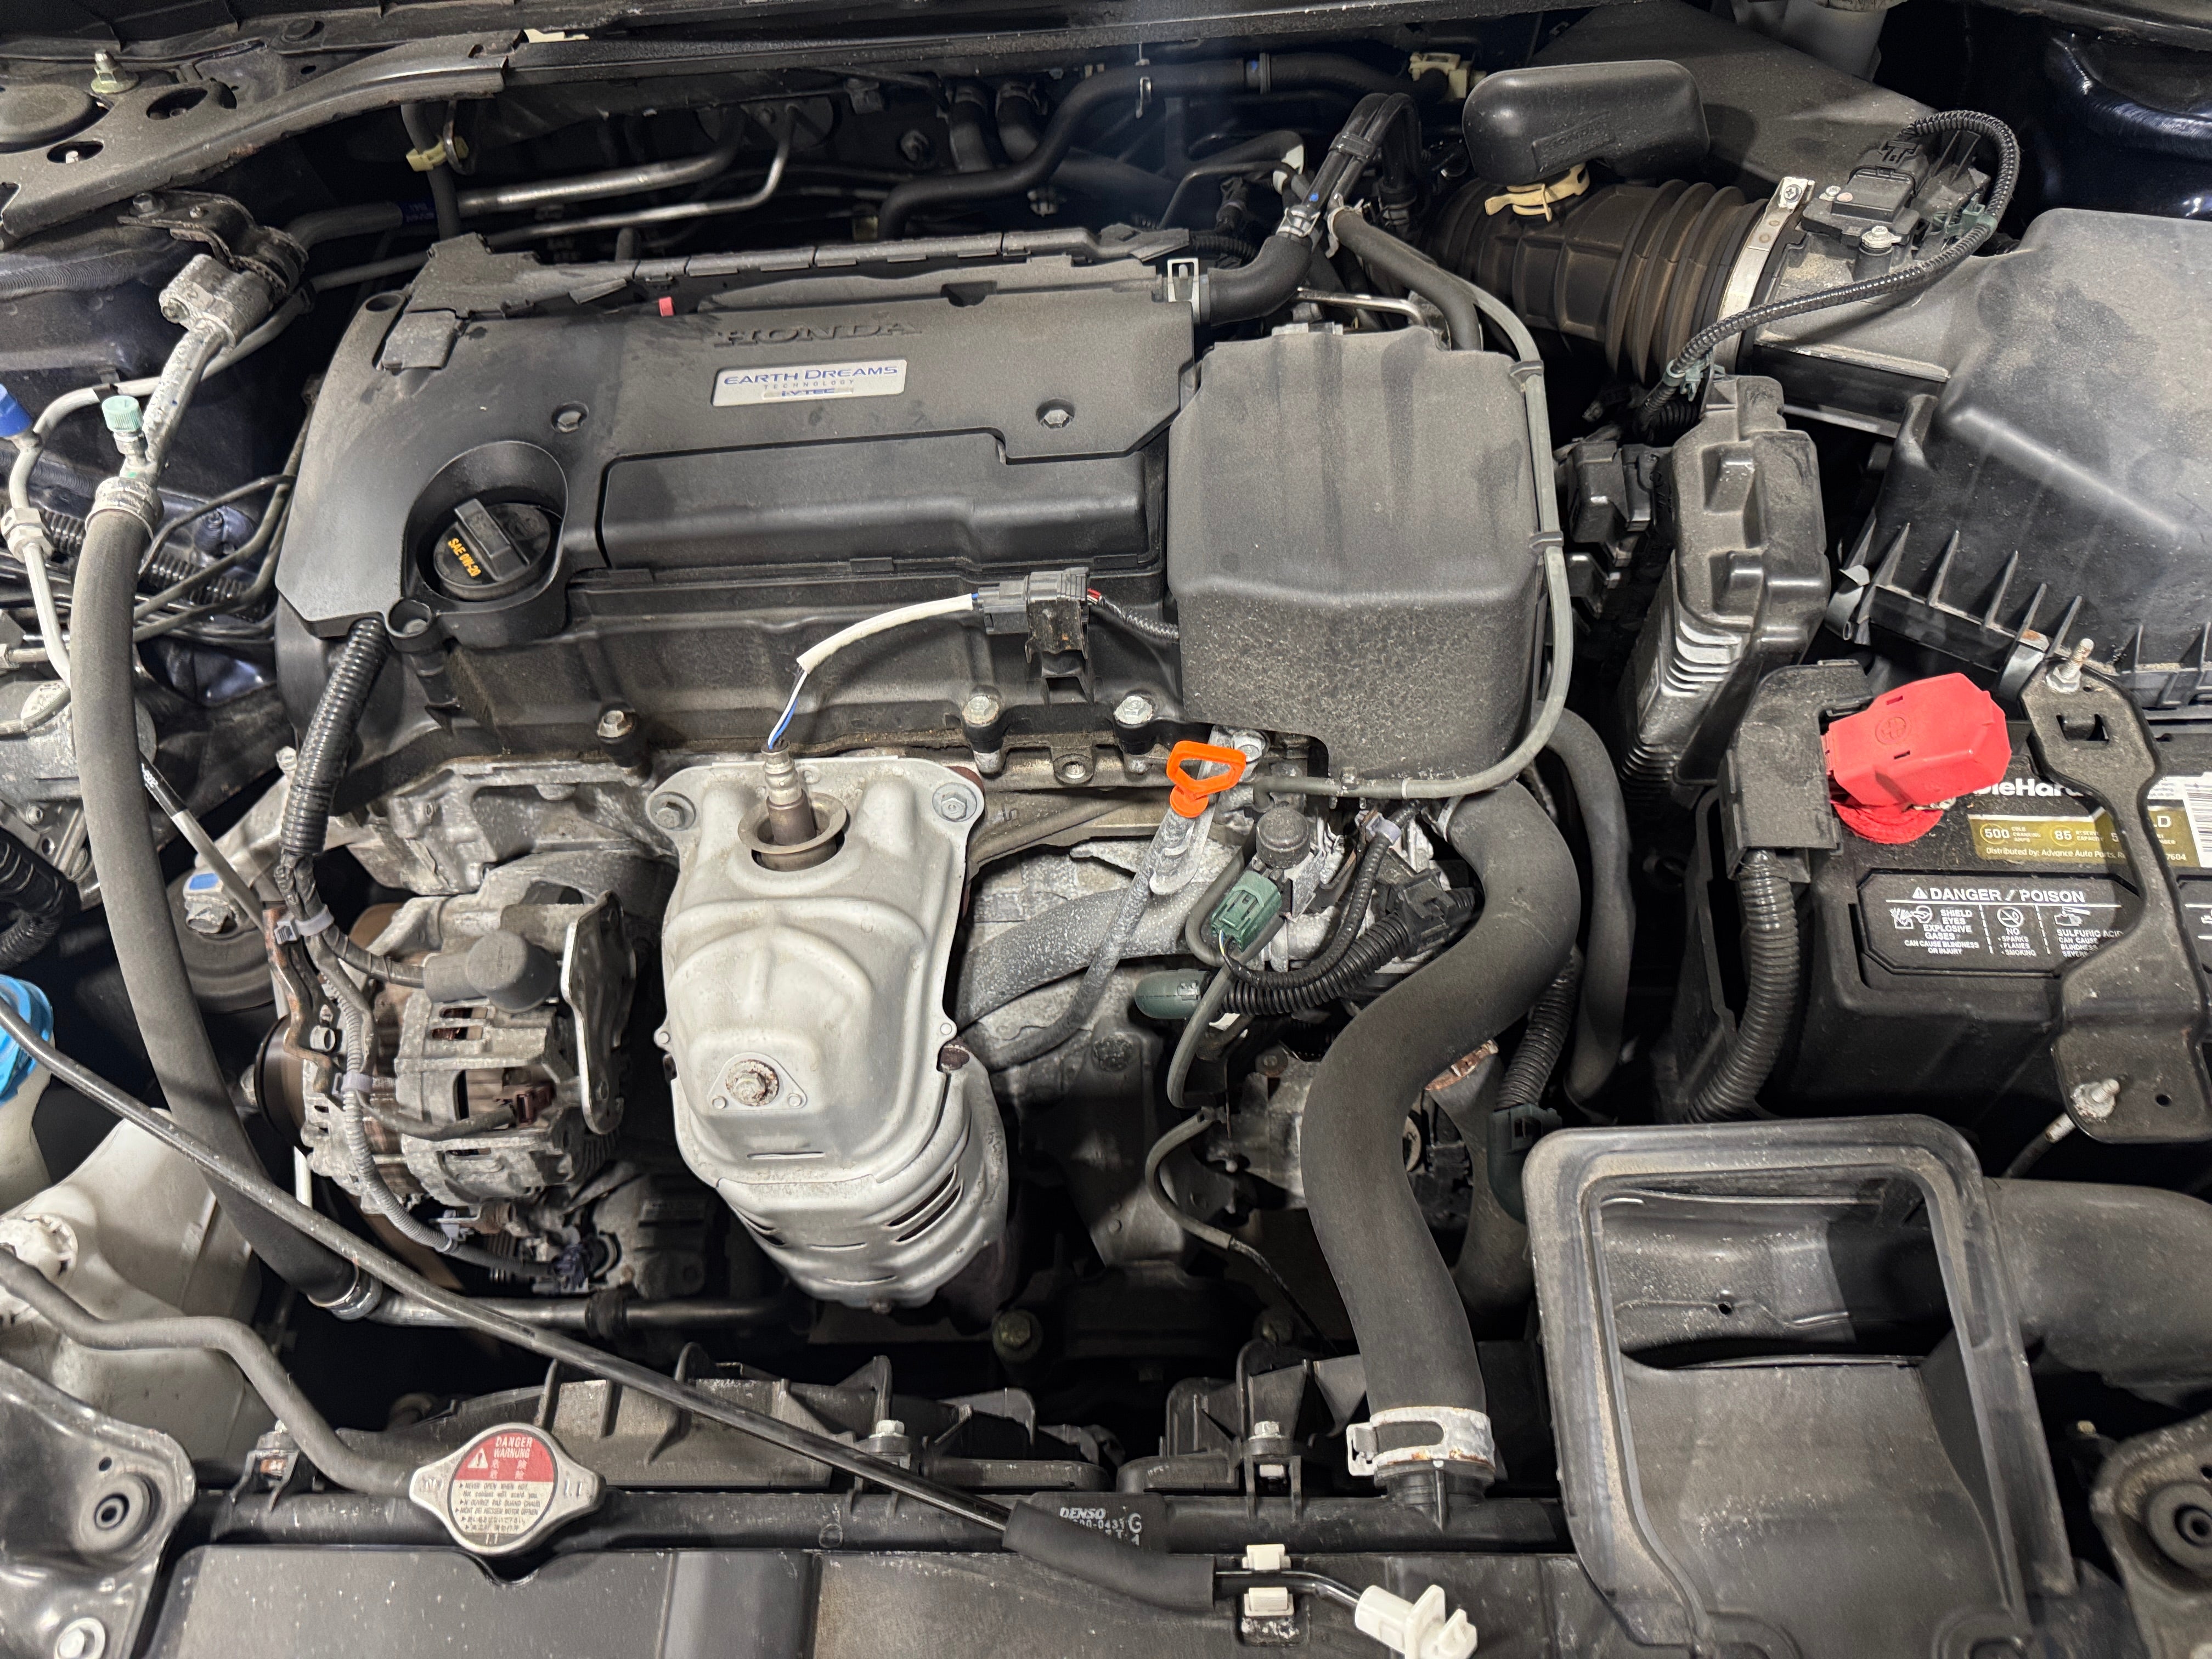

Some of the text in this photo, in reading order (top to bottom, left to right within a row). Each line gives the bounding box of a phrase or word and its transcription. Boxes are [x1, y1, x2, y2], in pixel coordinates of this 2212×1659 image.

[714, 322, 923, 348] HONDA
[724, 366, 898, 385] EARTH DREAMS
[764, 379, 855, 390] TECHNOLOGY
[448, 538, 482, 577] SAE 0W-20
[2153, 815, 2172, 828] D
[1984, 828, 2010, 839] 500
[2055, 830, 2072, 840] 85
[1987, 847, 2027, 856] Distributed
[2028, 848, 2039, 857] by:
[2041, 849, 2073, 857] Advance
[1930, 888, 2001, 901] DANGER
[2019, 890, 2085, 902] POISON
[1940, 909, 1973, 917] SHIELD
[1923, 924, 1972, 933] EXPLOSIVE
[2056, 929, 2101, 938] SULFURIC
[1942, 941, 1979, 949] BLINDNESS
[495, 1436, 534, 1448] DANGER
[493, 1447, 531, 1459] WARNUNG
[1059, 1506, 1107, 1520] DENSO
[1128, 1513, 1142, 1533] G
